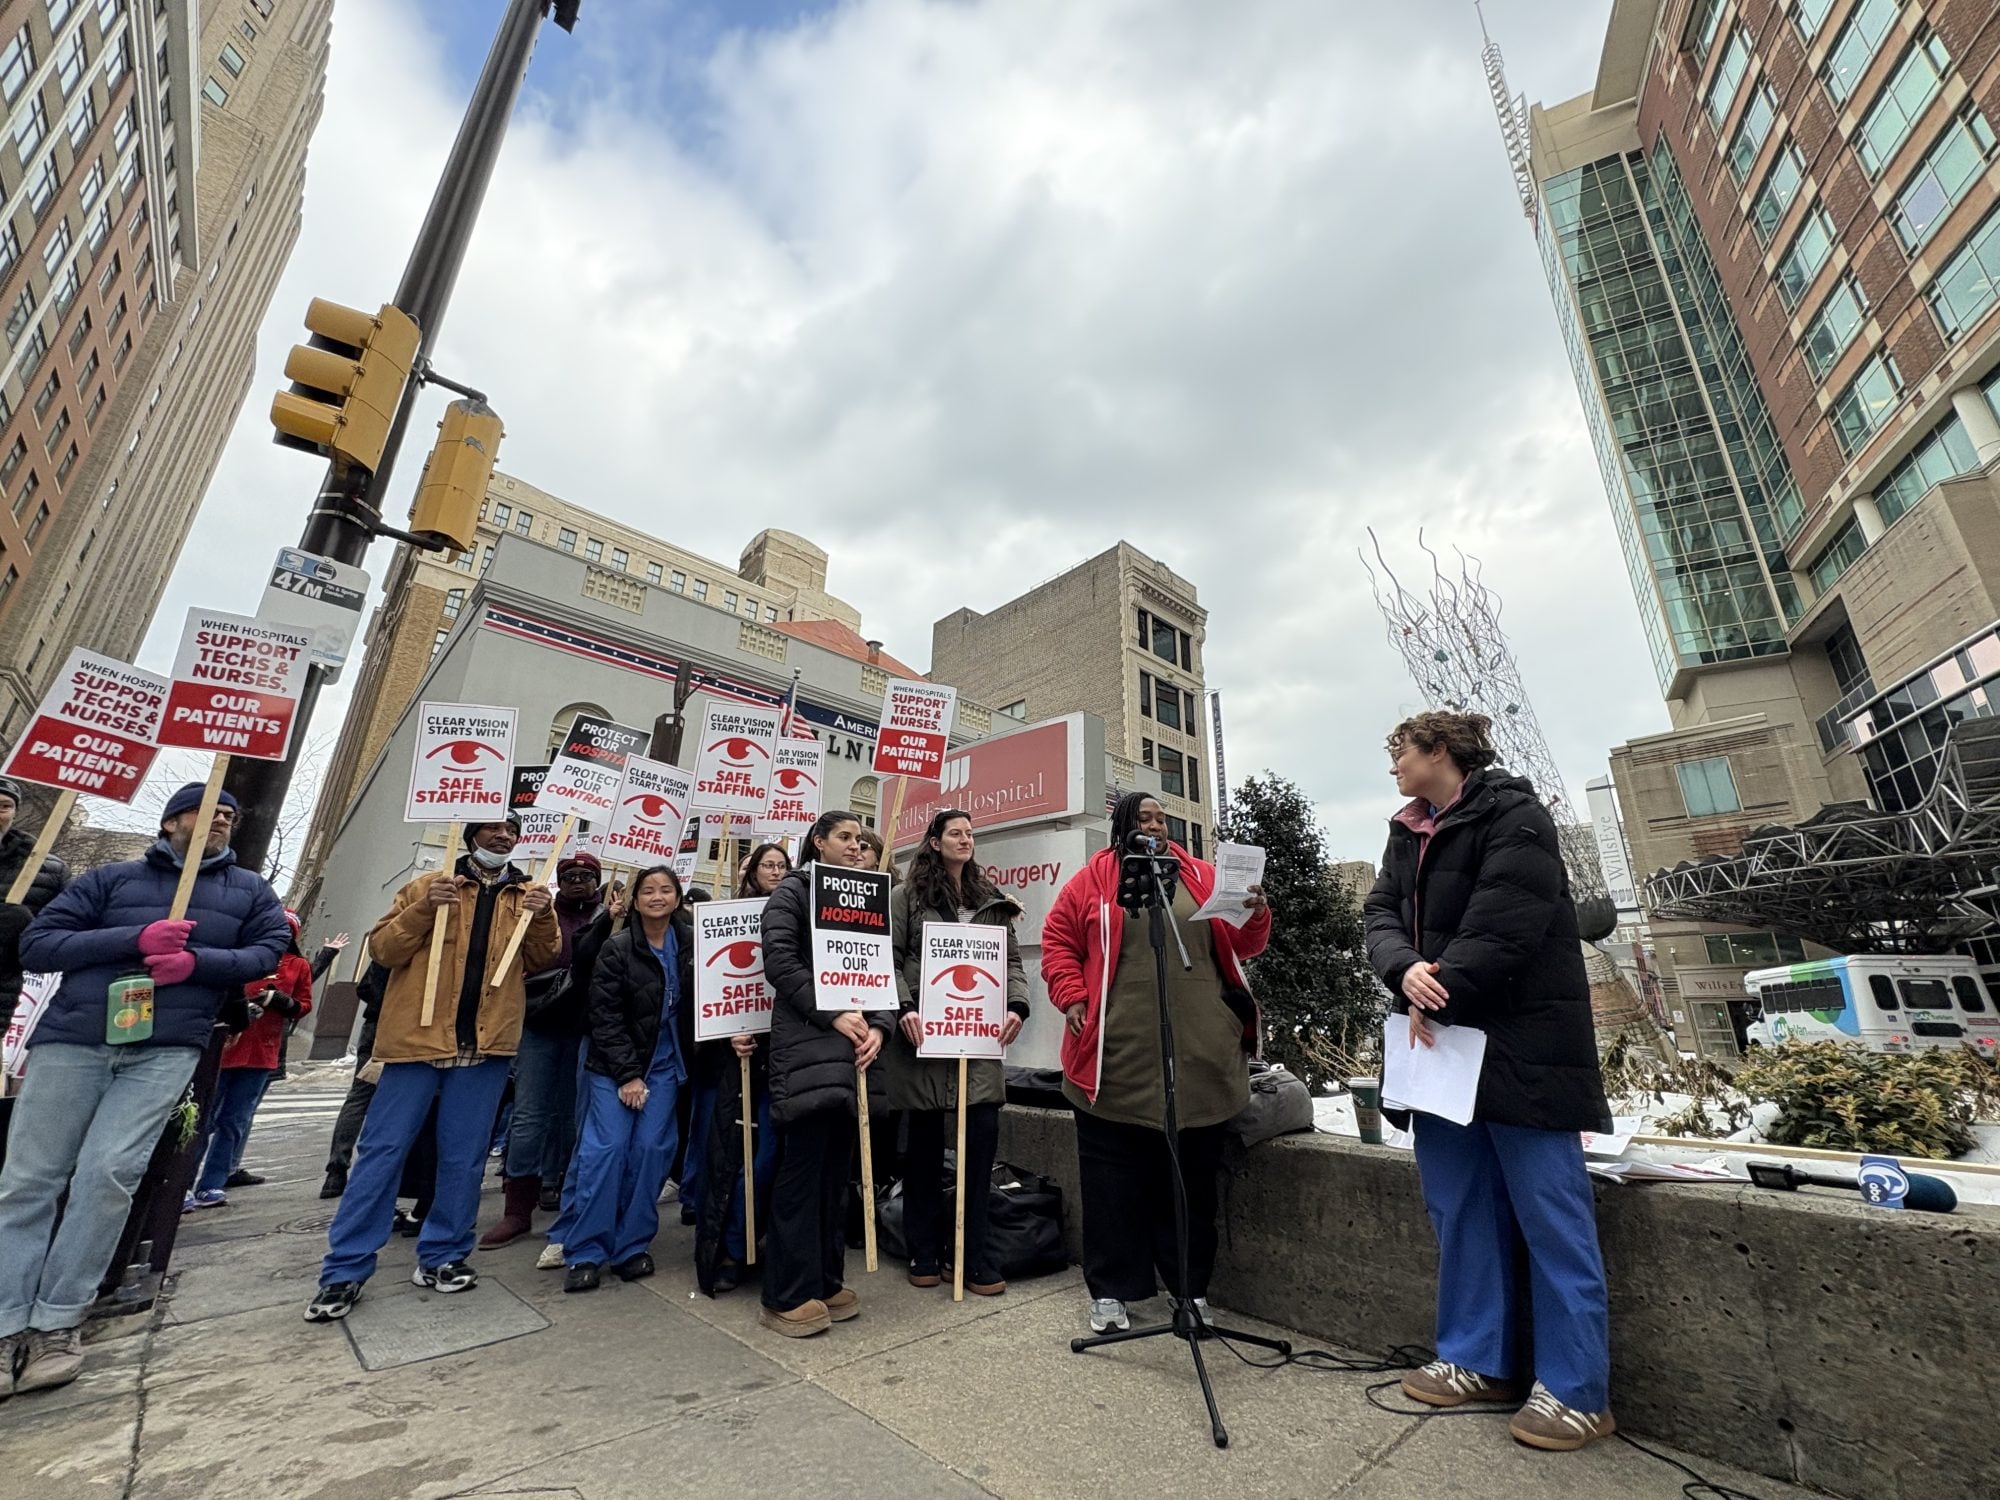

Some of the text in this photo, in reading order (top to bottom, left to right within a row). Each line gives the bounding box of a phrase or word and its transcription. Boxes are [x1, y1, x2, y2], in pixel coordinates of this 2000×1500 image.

[274, 571, 323, 600] 47M
[201, 619, 308, 646] WHEN HOSPITALS
[195, 631, 301, 661] SUPPORT
[199, 648, 289, 676] TECHS &
[80, 660, 166, 695] WHEN HOSPIT
[192, 663, 287, 693] NURSES,
[70, 671, 162, 709] SUPPOR
[893, 685, 951, 700] WHEN HOSPITALS
[73, 688, 159, 725] TECHS &
[210, 694, 261, 714] OUR
[891, 693, 948, 709] SUPPORT
[173, 706, 282, 734] PATIENTS
[710, 713, 775, 729] CLEAR VISION
[893, 704, 942, 720] TECHS &
[60, 702, 152, 741] NURSES,
[427, 716, 509, 729] CLEAR VISION
[710, 723, 772, 738] STARTS WITH
[834, 714, 878, 738] AMERI
[890, 715, 941, 732] NURSES,
[203, 728, 250, 748] WIN
[428, 726, 506, 738] STARTS WITH
[580, 722, 639, 746] PROTECT
[73, 734, 124, 757] OUR
[591, 736, 620, 752] OUR
[900, 735, 928, 748] OUR
[29, 741, 139, 780] PATIENTS
[568, 742, 626, 765] HOSPITA
[791, 750, 819, 759] VISION
[796, 758, 817, 767] WITH
[881, 745, 939, 762] PATIENTS
[897, 759, 922, 773] WIN
[58, 765, 106, 789] WIN
[438, 777, 484, 790] SAFE
[563, 765, 620, 787] PROTECT
[629, 767, 689, 792] CLEAR VISION
[716, 770, 752, 785] SAFE
[573, 778, 602, 794] OUR
[628, 776, 686, 799] STARTS WITH
[697, 780, 766, 799] STAFFING
[957, 771, 1044, 812] Hospital
[415, 790, 502, 804] STAFFING
[772, 799, 804, 811] SAFE
[526, 824, 552, 834] OUR
[628, 824, 662, 842] SAFE
[517, 834, 573, 844] ONTRAT
[608, 832, 673, 858] STAFFING
[1599, 815, 1625, 882] WillsEye
[986, 862, 1061, 889] Surgery
[823, 876, 879, 897] PROTECT
[838, 893, 866, 909] OUR
[702, 915, 738, 928] CLEAR
[821, 906, 885, 927] HOSPITAL
[704, 926, 747, 939] STARTS
[826, 939, 880, 957] PROTECT
[929, 938, 1000, 951] CLEAR VISION
[842, 956, 868, 971] OUR
[931, 948, 998, 961] STARTS WITH
[820, 971, 891, 988] CONTRACT
[722, 982, 765, 1000] SAFE
[702, 996, 772, 1018] STAFFIN
[944, 1006, 984, 1022] SAFE
[8, 1023, 25, 1036] FE
[924, 1021, 1001, 1038] STAFFING
[1869, 1182, 1881, 1202] abc
